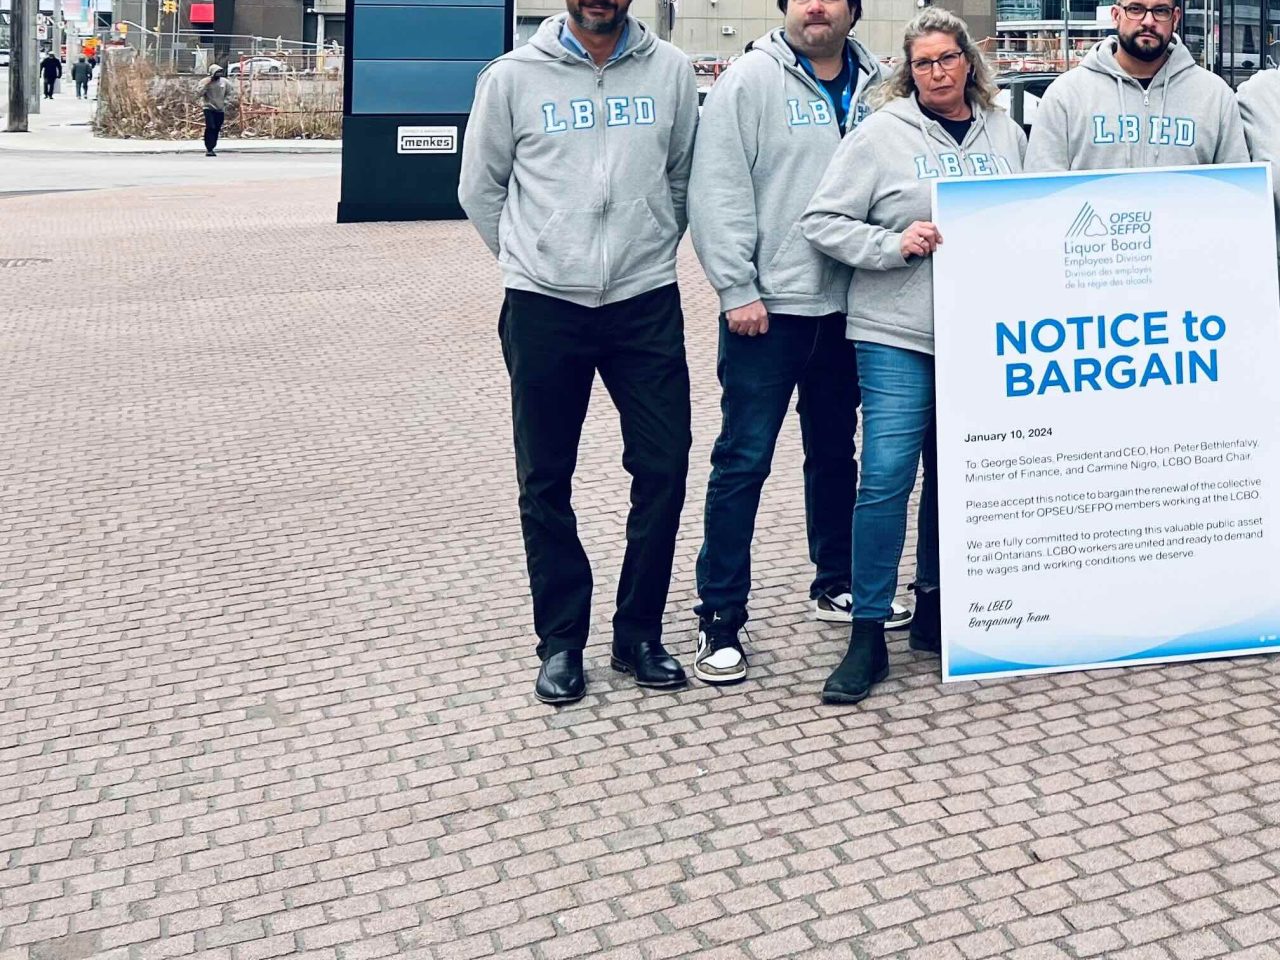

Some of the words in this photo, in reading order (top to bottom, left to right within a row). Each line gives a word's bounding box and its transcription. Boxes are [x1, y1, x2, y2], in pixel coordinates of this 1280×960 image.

[542, 96, 656, 134] LBED
[405, 138, 450, 147] menkes
[1093, 115, 1196, 146] LBED
[1110, 211, 1152, 224] OPSEU
[1110, 223, 1151, 235] SEFPO
[1064, 241, 1105, 257] Liquor
[1111, 235, 1152, 251] Board
[1064, 255, 1113, 268] Employees
[1116, 253, 1152, 263] Division
[1065, 269, 1096, 278] Division
[1099, 267, 1112, 276] des
[1065, 280, 1076, 289] de
[1078, 279, 1086, 288] la
[1109, 277, 1123, 286] des
[1126, 275, 1152, 286] alcools
[996, 311, 1169, 355] NOTICE
[1183, 309, 1226, 341] to
[1005, 348, 1219, 397] BARGAIN
[964, 432, 1007, 442] January
[1010, 429, 1025, 439] 10,
[1028, 427, 1053, 438] 2024
[965, 471, 1005, 483] Minister
[1008, 470, 1018, 479] of
[1020, 468, 1063, 478] Finance,
[1065, 465, 1084, 475] and
[1087, 463, 1128, 473] Carmine
[1131, 460, 1160, 471] Nigro,
[1162, 456, 1192, 467] LCBO
[1194, 453, 1223, 464] Board
[981, 458, 1017, 469] George
[1056, 450, 1102, 461] President
[1104, 448, 1122, 458] and
[1174, 443, 1199, 453] Peter
[966, 500, 999, 509] Please
[1000, 496, 1034, 507] accept
[1036, 495, 1054, 504] this
[1055, 491, 1085, 502] notice
[1087, 491, 1096, 499] to
[1097, 489, 1134, 499] bargain
[1135, 487, 1150, 496] the
[1151, 483, 1188, 494] renewal
[1190, 482, 1199, 491] of
[1201, 481, 1215, 490] the
[1217, 478, 1262, 489] collective
[966, 510, 1019, 524] agreement
[1021, 509, 1035, 518] for
[1036, 502, 1113, 517] OPSEU/SEFPO
[1115, 500, 1160, 511] members
[1162, 496, 1201, 507] working
[1202, 495, 1211, 503] at
[1213, 493, 1228, 502] the
[966, 540, 983, 550] We
[985, 540, 1001, 548] are
[1003, 537, 1023, 548] fully
[1025, 532, 1079, 545] committed
[1081, 532, 1091, 540] to
[1093, 527, 1142, 541] protecting
[1144, 525, 1162, 535] this
[1164, 522, 1204, 533] valuable
[1206, 519, 1235, 530] public
[1237, 517, 1263, 527] asset
[967, 554, 982, 563] for
[982, 553, 992, 561] all
[1047, 545, 1077, 556] LCBO
[1078, 543, 1117, 554] workers
[1118, 541, 1133, 550] are
[1135, 538, 1164, 549] united
[1166, 536, 1184, 546] and
[1185, 534, 1212, 544] ready
[1213, 533, 1223, 542] to
[1224, 529, 1263, 541] demand
[967, 568, 983, 577] the
[986, 565, 1018, 576] wages
[1021, 562, 1040, 572] and
[1043, 559, 1082, 570] working
[1085, 555, 1135, 567] conditions
[1139, 553, 1153, 562] we
[969, 602, 985, 613] The
[987, 599, 1013, 612] LBED
[968, 616, 1023, 632] Bargaining
[1026, 612, 1050, 623] Team
